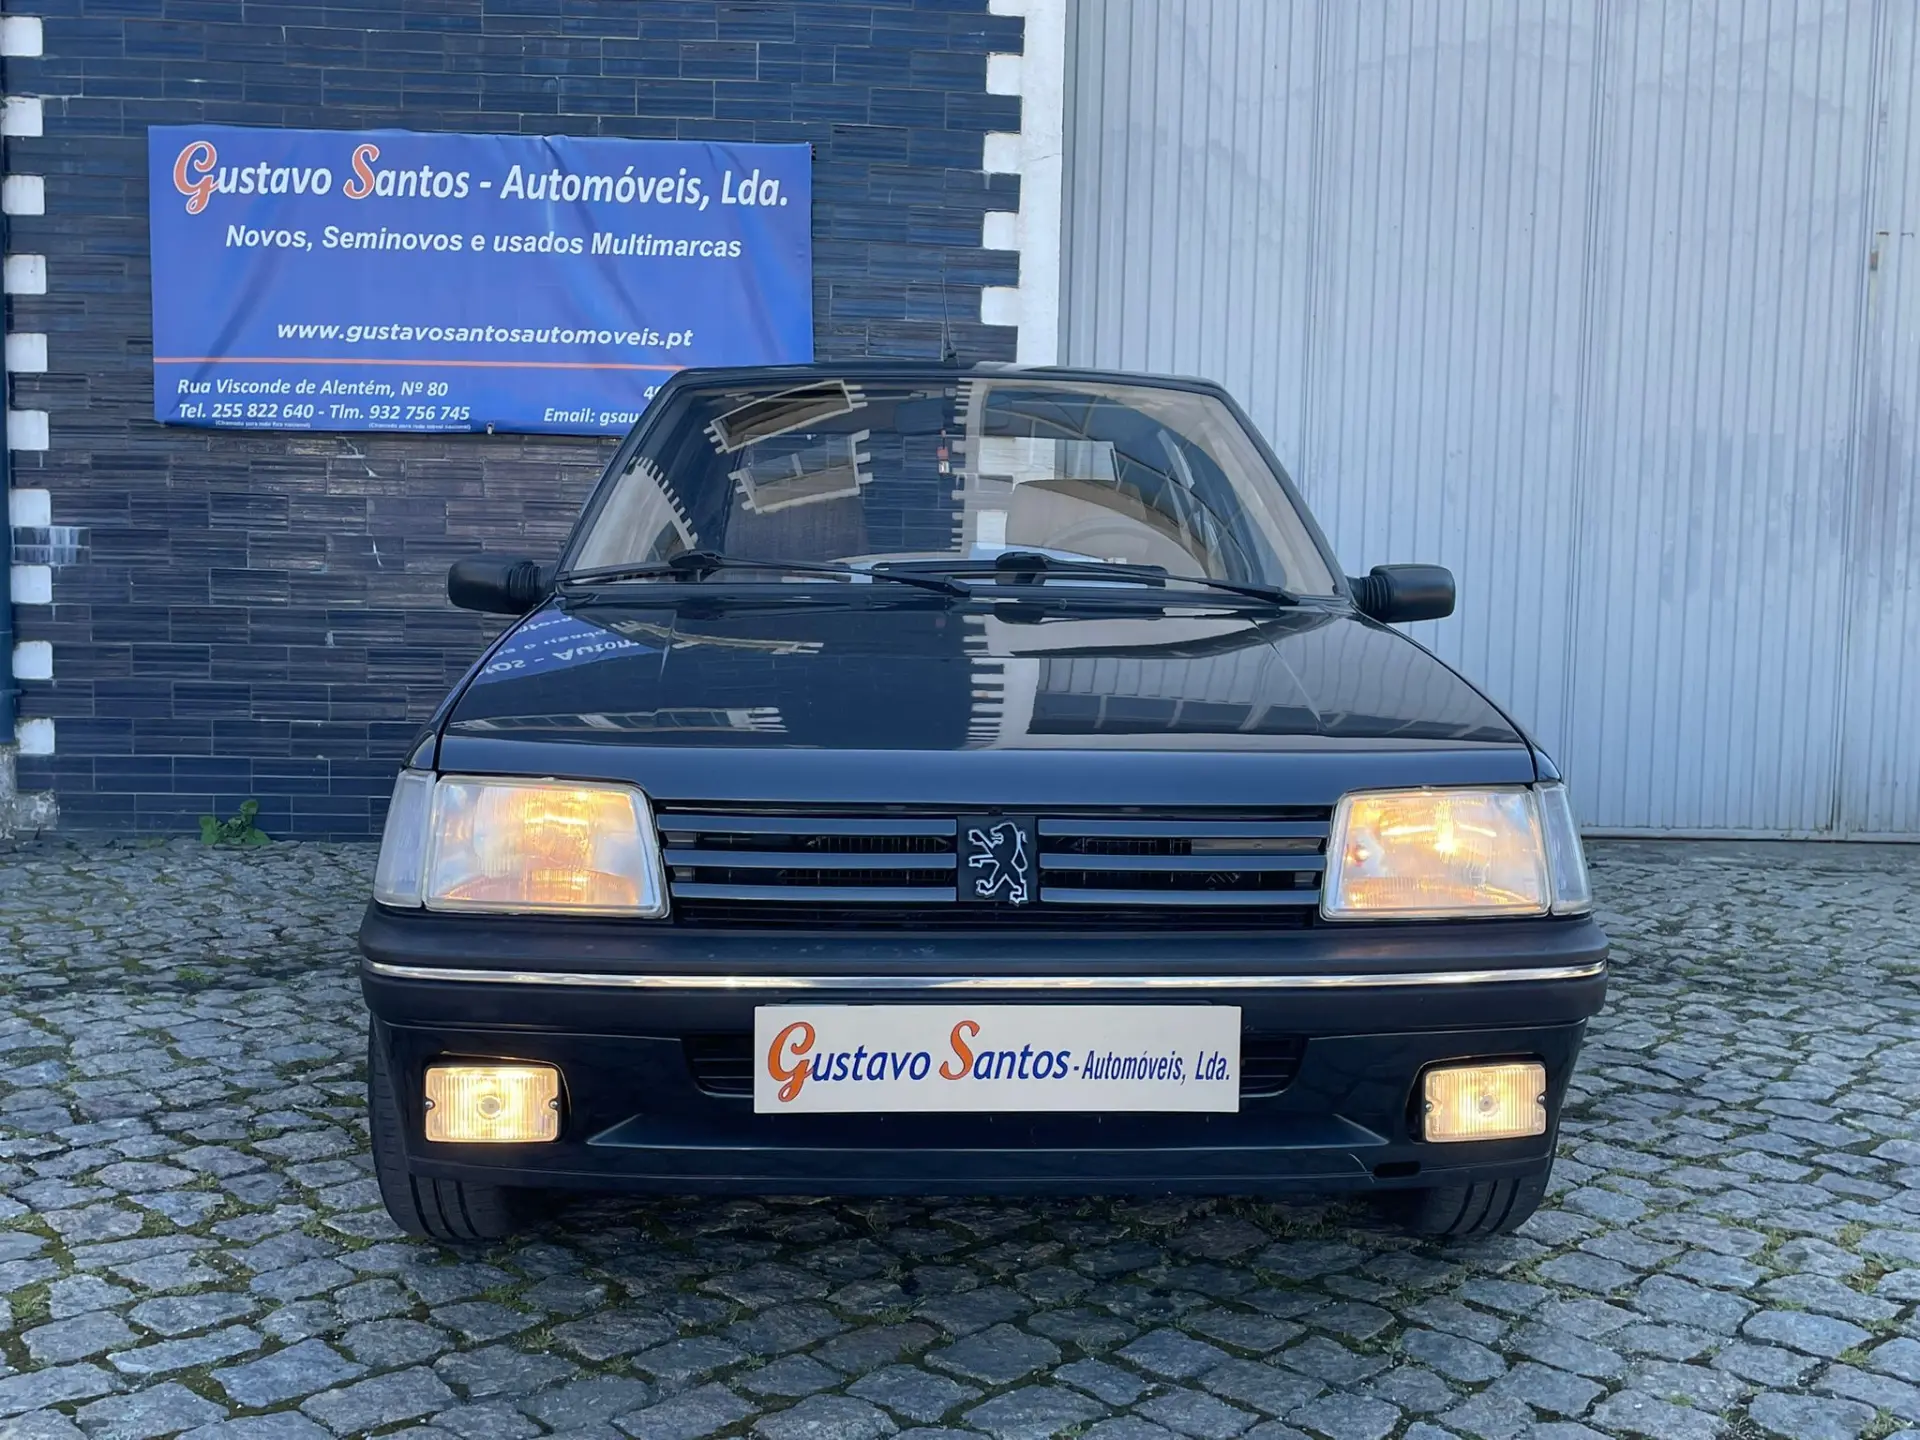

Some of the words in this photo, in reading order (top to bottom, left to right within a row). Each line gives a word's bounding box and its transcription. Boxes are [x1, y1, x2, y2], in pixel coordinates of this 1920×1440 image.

[173, 140, 332, 215] Gustavo
[343, 143, 470, 200] Santos
[479, 180, 492, 189] -
[499, 164, 710, 211] Automóveis,
[721, 168, 789, 206] Lda.
[225, 224, 314, 252] Novos,
[322, 225, 463, 251] Seminovos
[471, 237, 486, 252] e
[493, 231, 584, 254] usados
[591, 232, 742, 257] Multimarcas
[277, 323, 694, 349] www.gustavosantosautomoveis.pt
[177, 378, 211, 394] Rua
[216, 378, 291, 395] Visconde
[295, 379, 316, 395] de
[319, 380, 396, 398] Alentém,
[427, 381, 449, 397] 80
[178, 403, 207, 419] Tel.
[211, 403, 242, 419] 255
[246, 404, 278, 419] 822
[282, 404, 315, 419] 640
[329, 404, 364, 420] Tlm.
[369, 404, 400, 420] 932
[404, 405, 436, 421] 756
[440, 405, 470, 421] 745
[543, 407, 596, 423] Email:
[766, 1020, 931, 1103] Gustavo
[938, 1019, 1070, 1081] Santos
[1081, 1050, 1186, 1086] Automóveis,
[1194, 1050, 1230, 1081] Lda.
